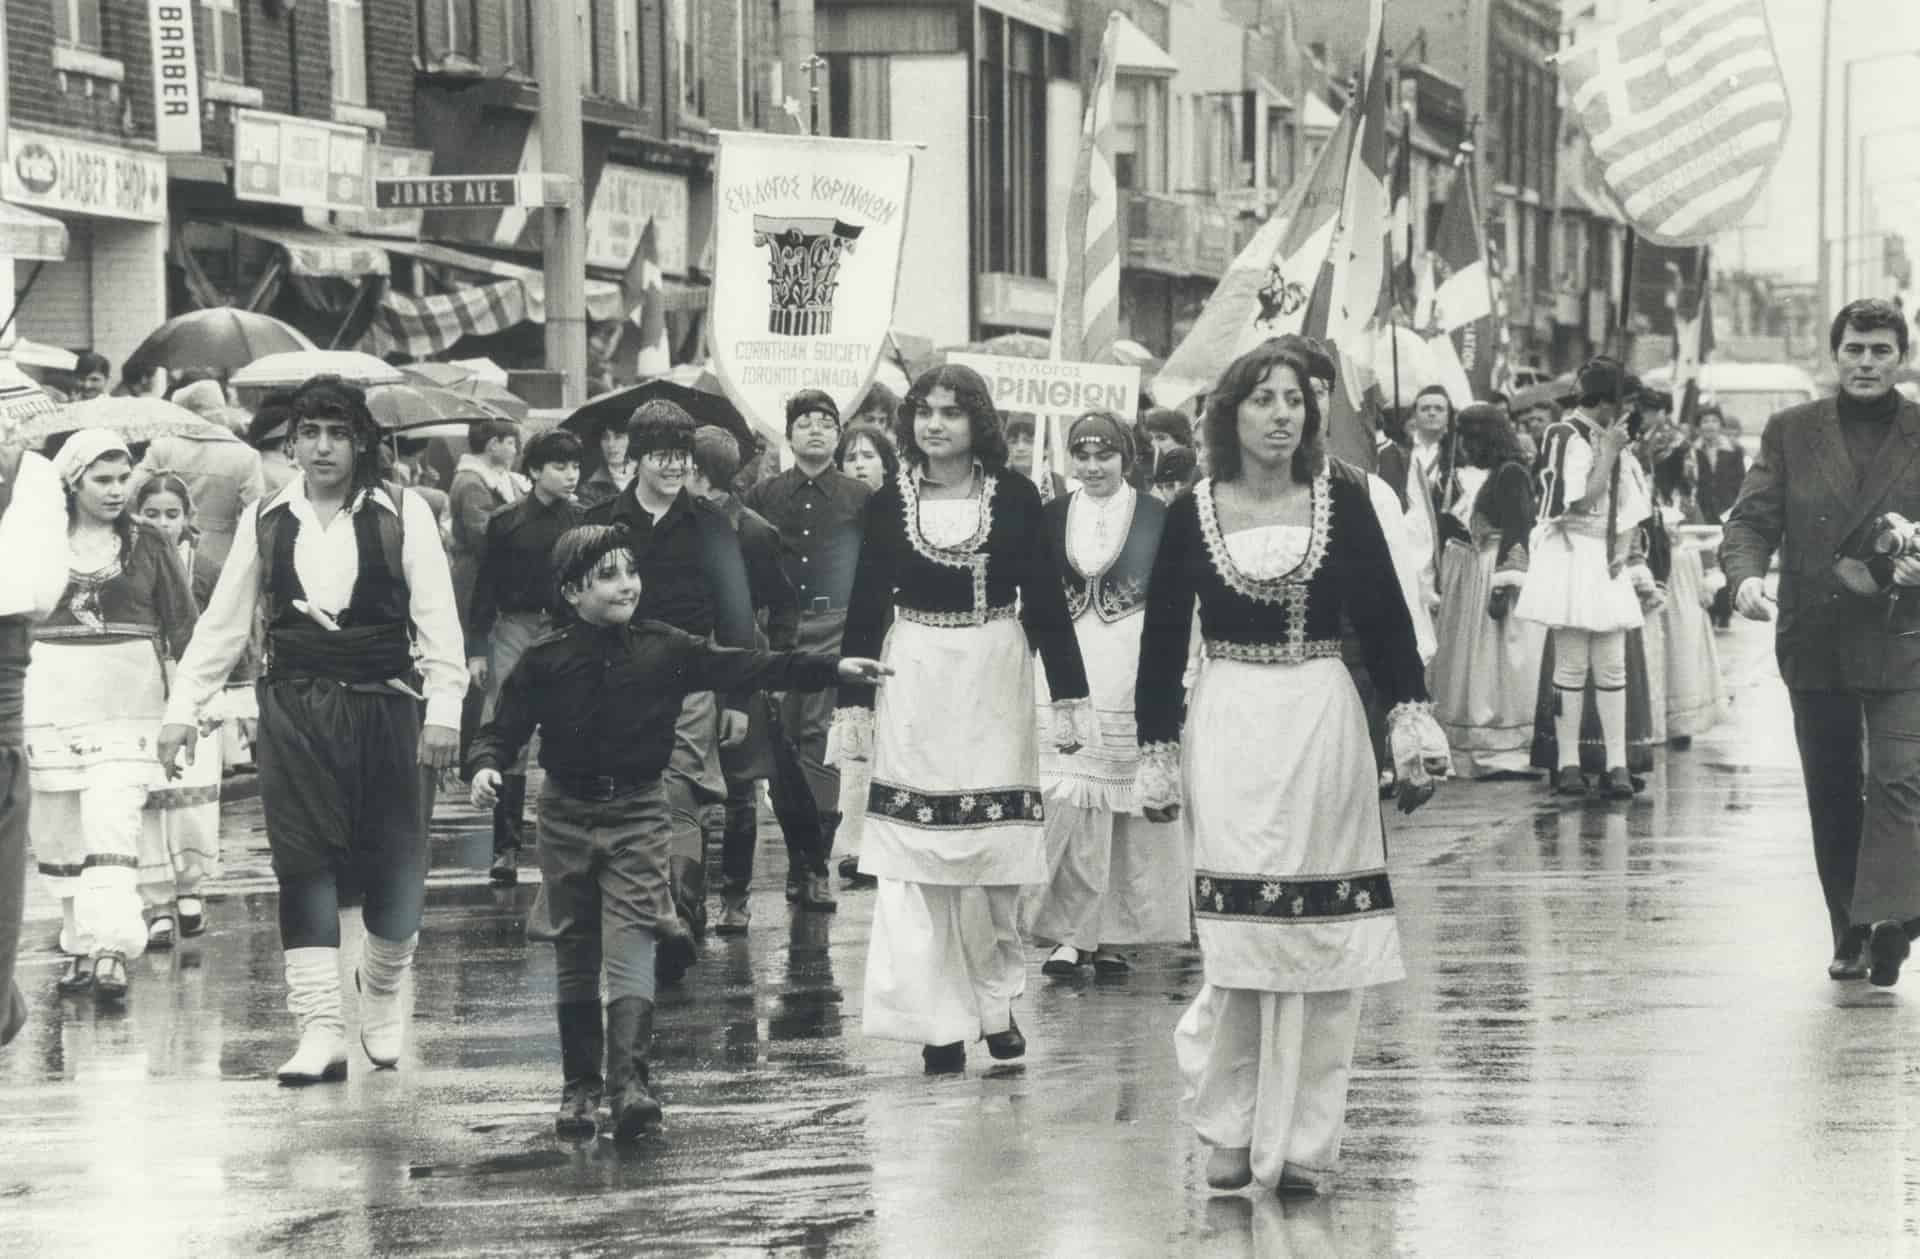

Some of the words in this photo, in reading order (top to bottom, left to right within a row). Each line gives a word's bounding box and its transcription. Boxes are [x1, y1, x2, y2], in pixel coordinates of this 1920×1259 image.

[159, 7, 188, 115] BARBER
[391, 182, 453, 204] JONES
[735, 341, 808, 361] CORINTHIAN
[814, 342, 874, 362] SOCIETY
[742, 366, 799, 386] TORONTO
[803, 367, 859, 388] CANADA
